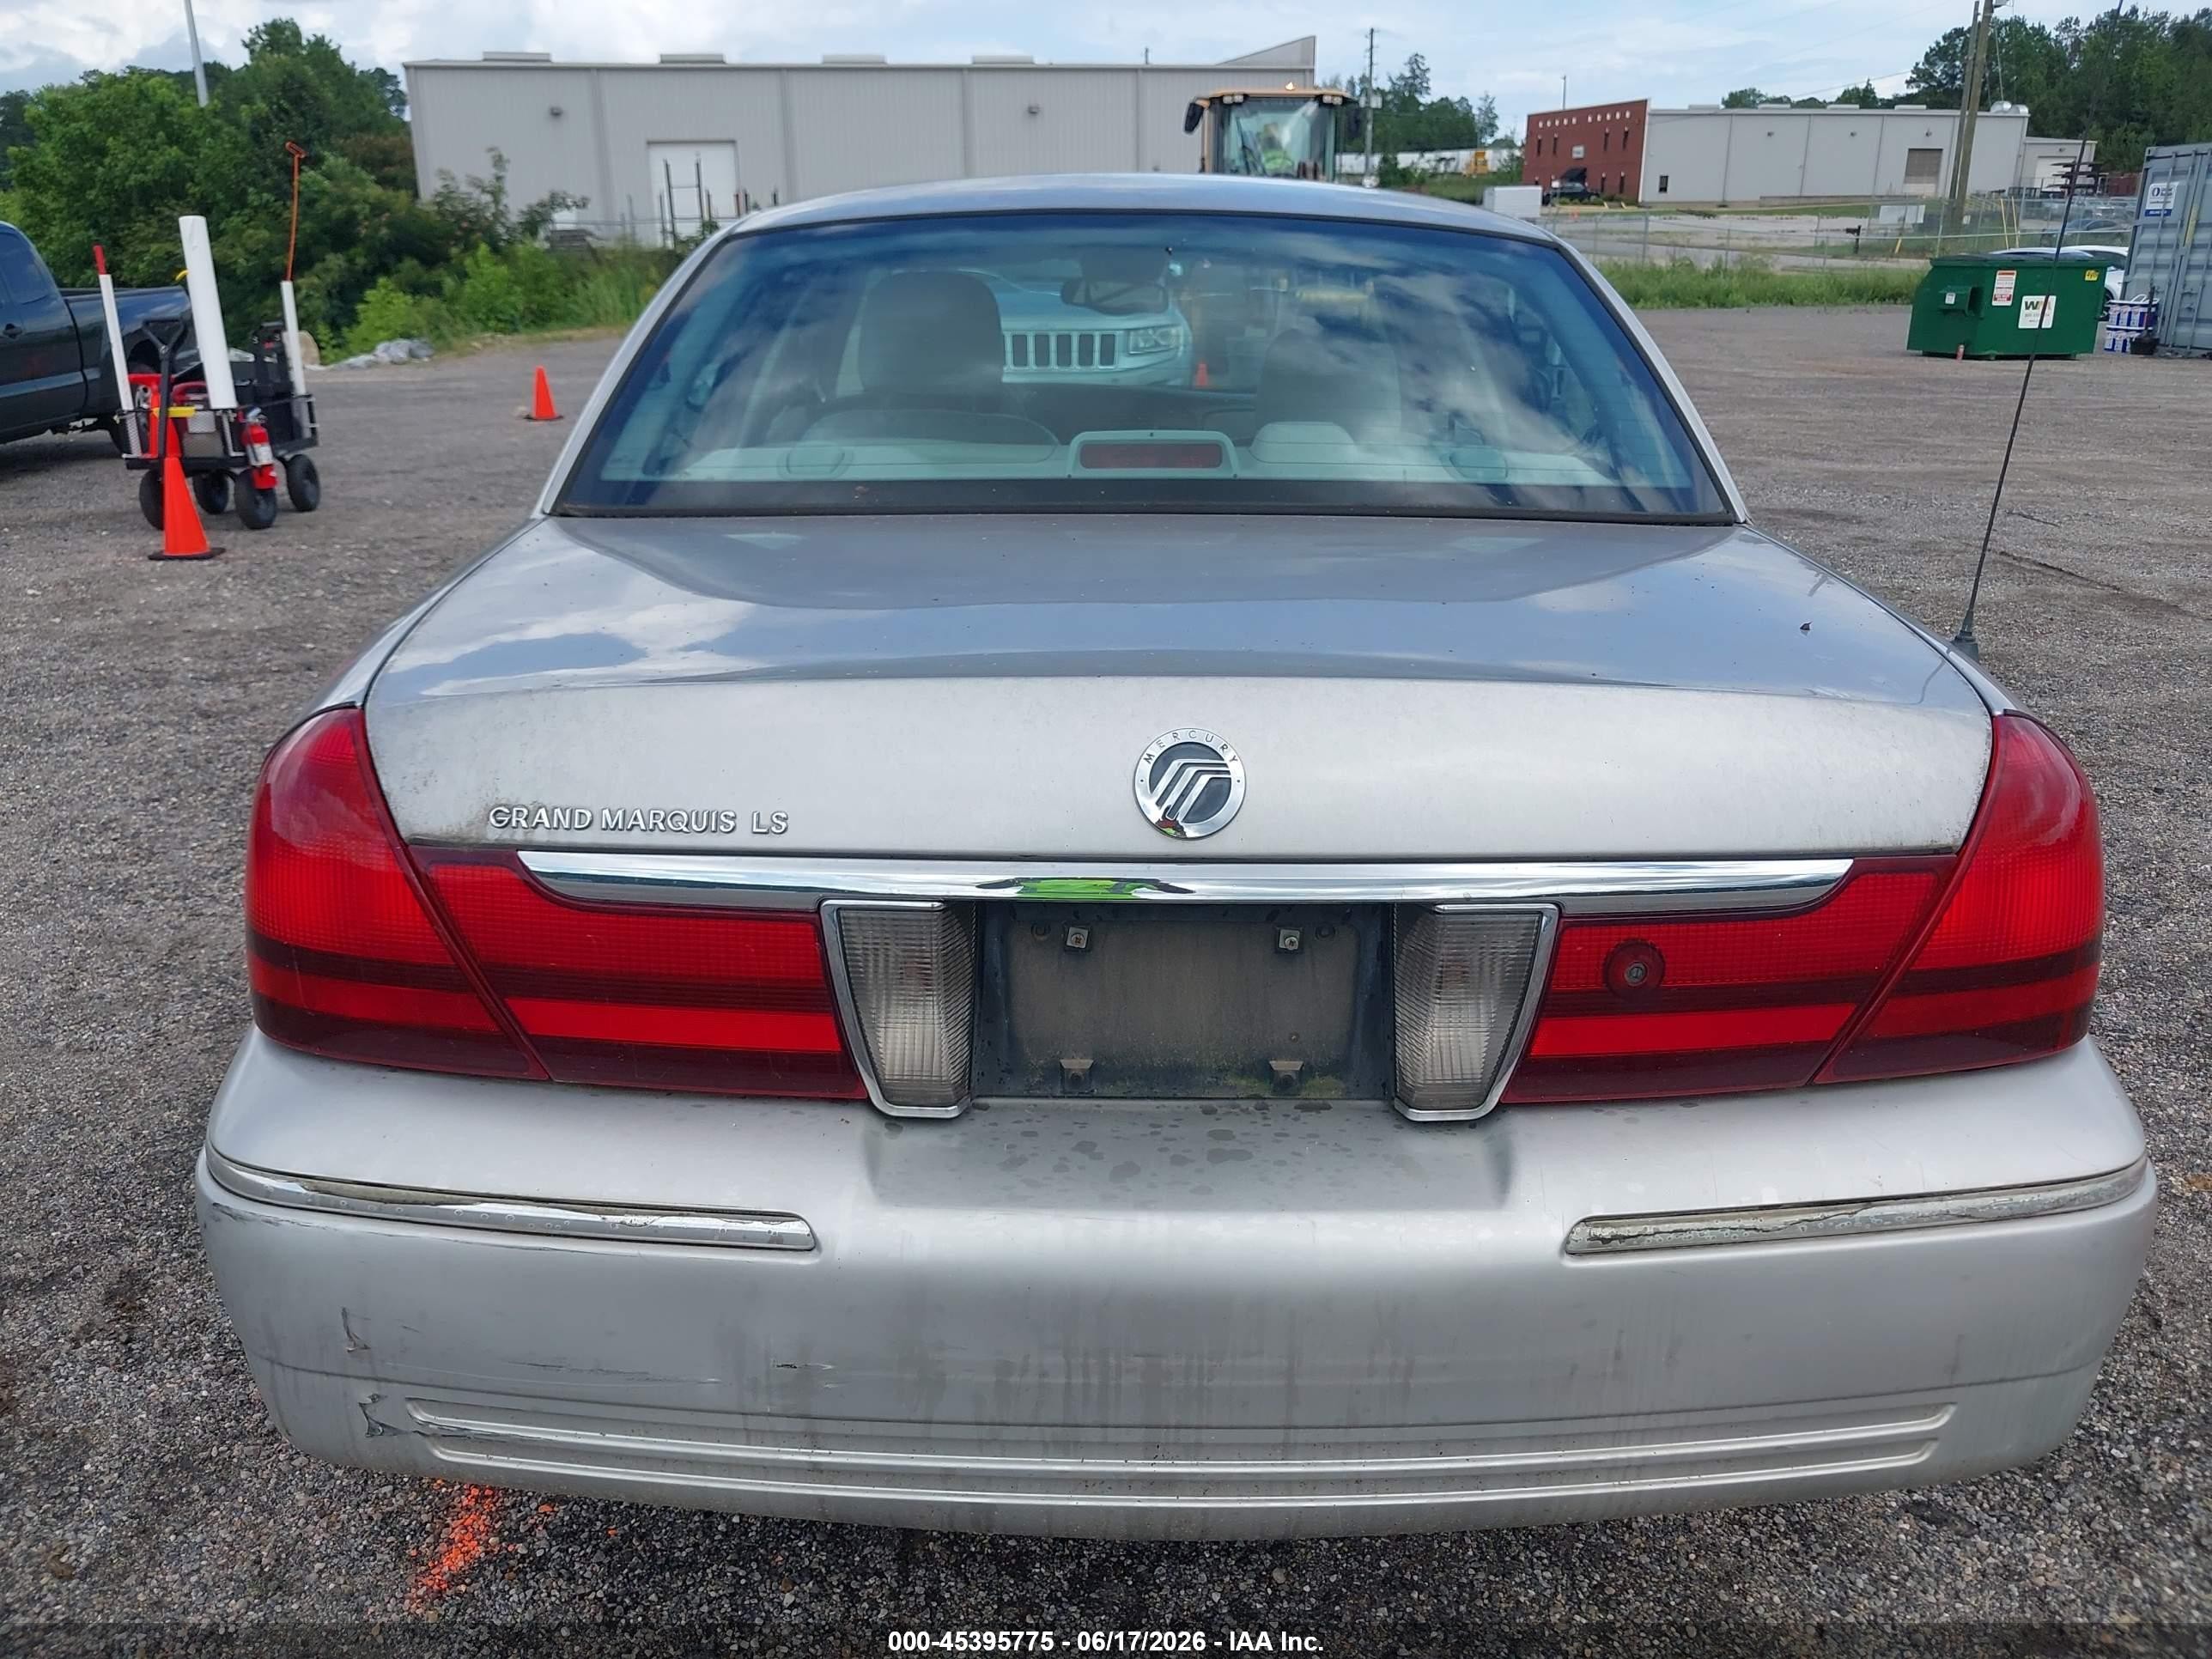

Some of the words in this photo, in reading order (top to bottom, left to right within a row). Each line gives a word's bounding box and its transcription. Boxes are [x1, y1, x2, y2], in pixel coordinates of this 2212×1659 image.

[1143, 730, 1239, 764] MERCURY
[489, 805, 593, 830] GRAND
[601, 808, 737, 834] MARQUIS
[751, 810, 789, 835] LS
